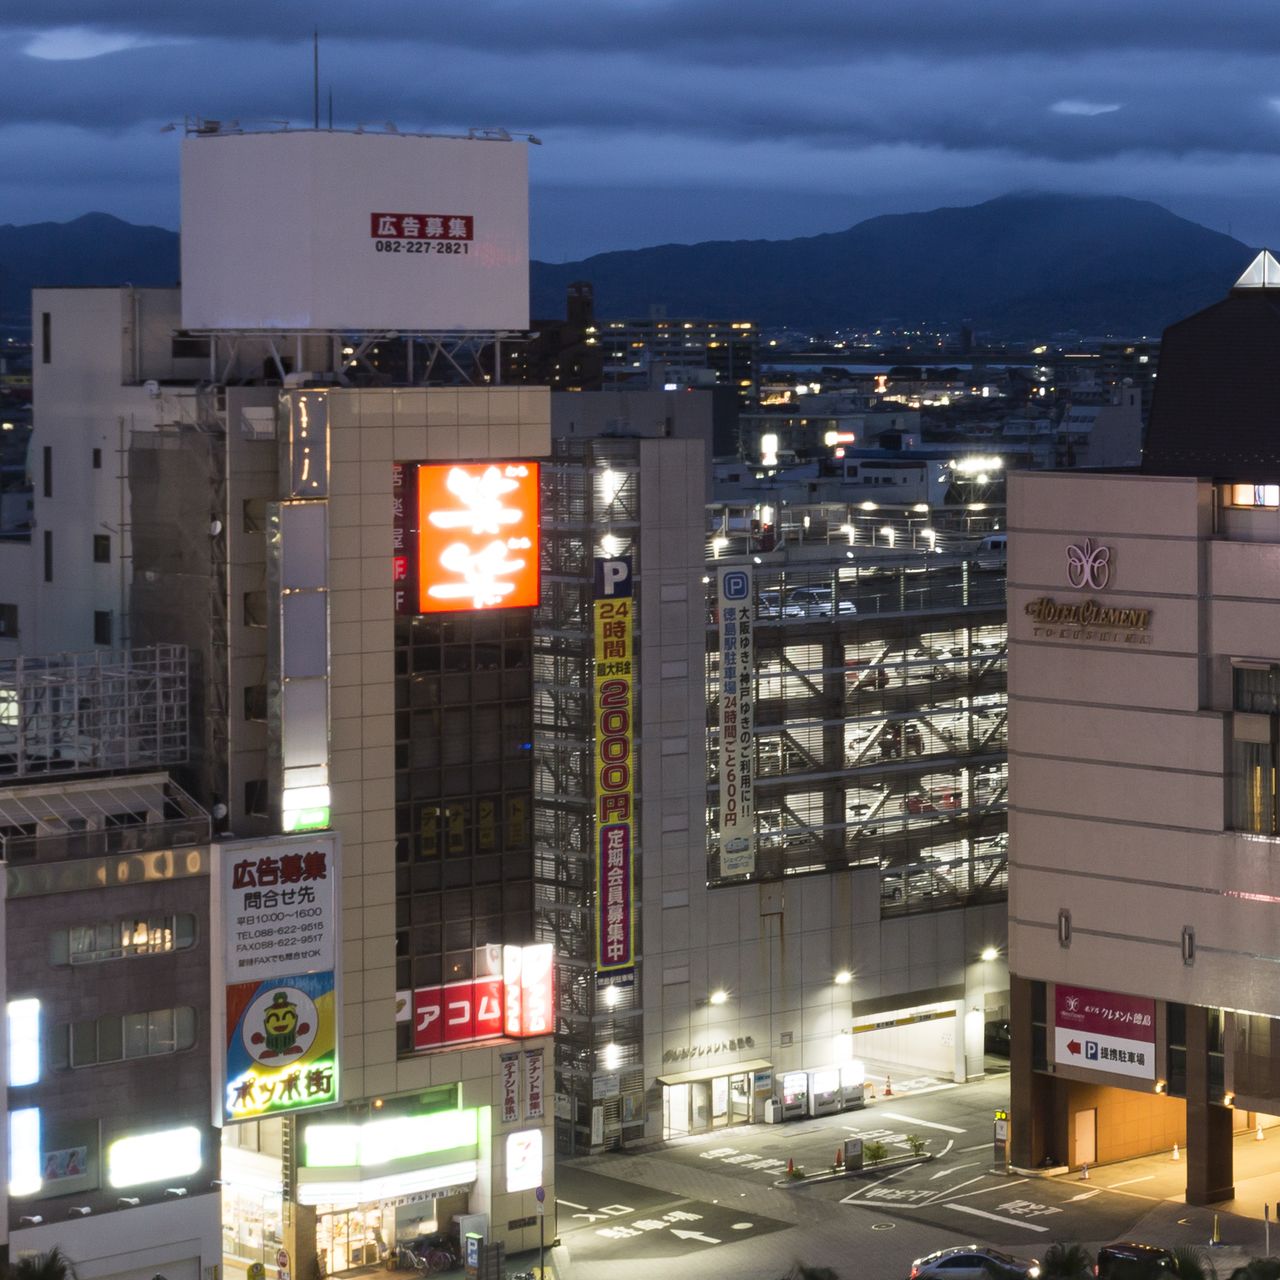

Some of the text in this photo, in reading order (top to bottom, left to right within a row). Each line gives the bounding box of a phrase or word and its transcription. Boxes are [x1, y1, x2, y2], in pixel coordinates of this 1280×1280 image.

[377, 216, 467, 237] 広告募集
[375, 240, 469, 254] 082-227-2821
[603, 561, 628, 595] P
[730, 578, 742, 595] P
[1024, 597, 1152, 629] HOTEL CLEMENT
[600, 602, 629, 659] 24時間
[600, 678, 630, 823] 2000円
[232, 851, 327, 890] 広告募集
[244, 886, 316, 911] 問合せ先
[607, 829, 624, 961] 定期会員募集中
[416, 996, 501, 1032] アコム
[1101, 1046, 1145, 1066] 提携駐車場
[528, 1056, 541, 1111] テナント募集
